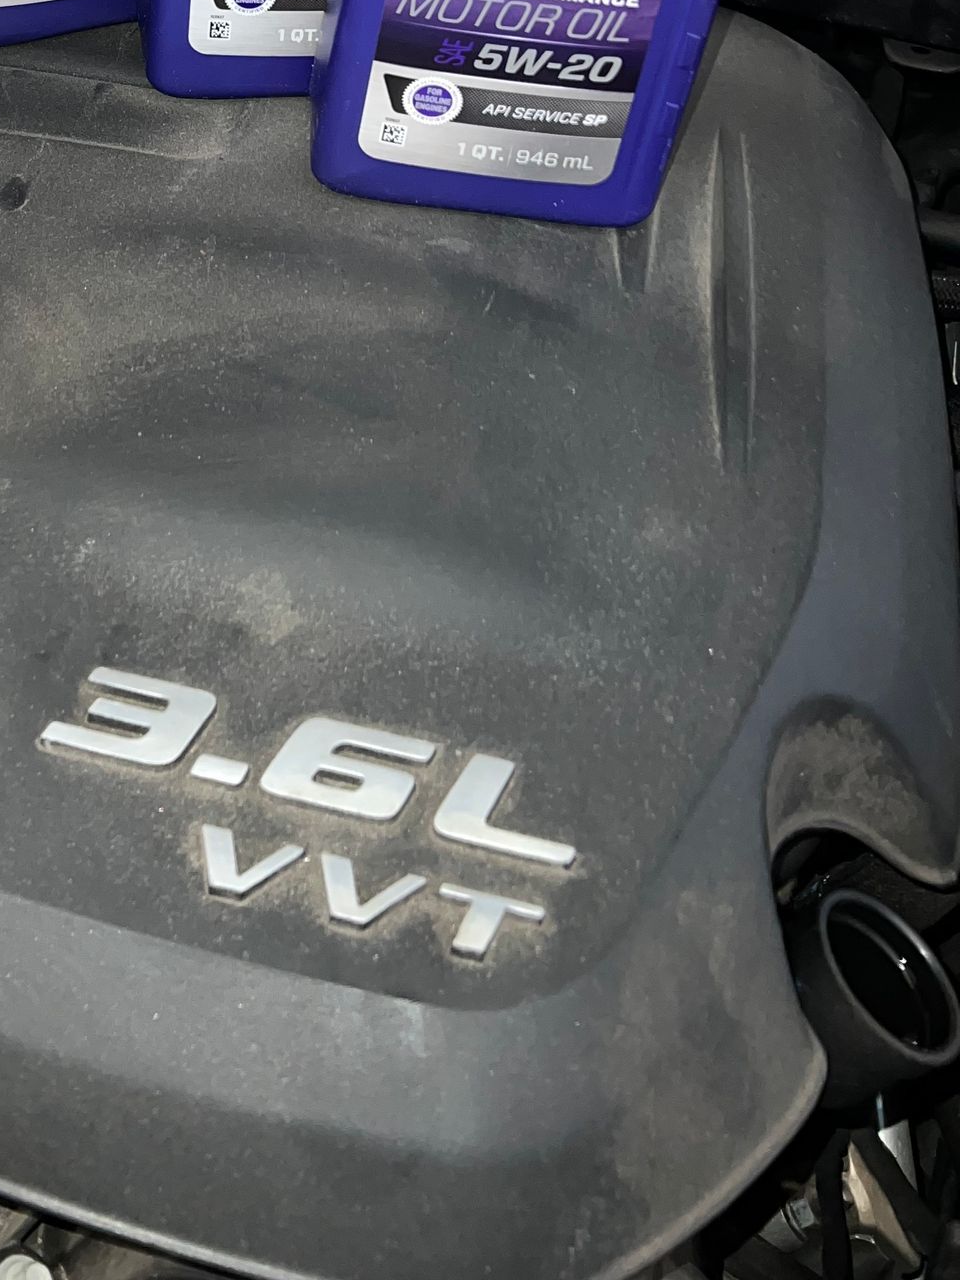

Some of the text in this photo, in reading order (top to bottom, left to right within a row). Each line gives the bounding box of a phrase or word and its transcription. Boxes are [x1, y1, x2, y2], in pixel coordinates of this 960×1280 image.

[278, 29, 319, 43] 1 QT.
[566, 8, 630, 43] OIL
[473, 43, 623, 84] 5W-20
[414, 93, 451, 106] GASOLINE
[426, 87, 442, 96] FOR
[482, 104, 609, 127] API SERVICE SP
[457, 142, 593, 170] 1 QT. 946 mL
[38, 666, 578, 867] 3.6L
[201, 823, 547, 961] VVT
